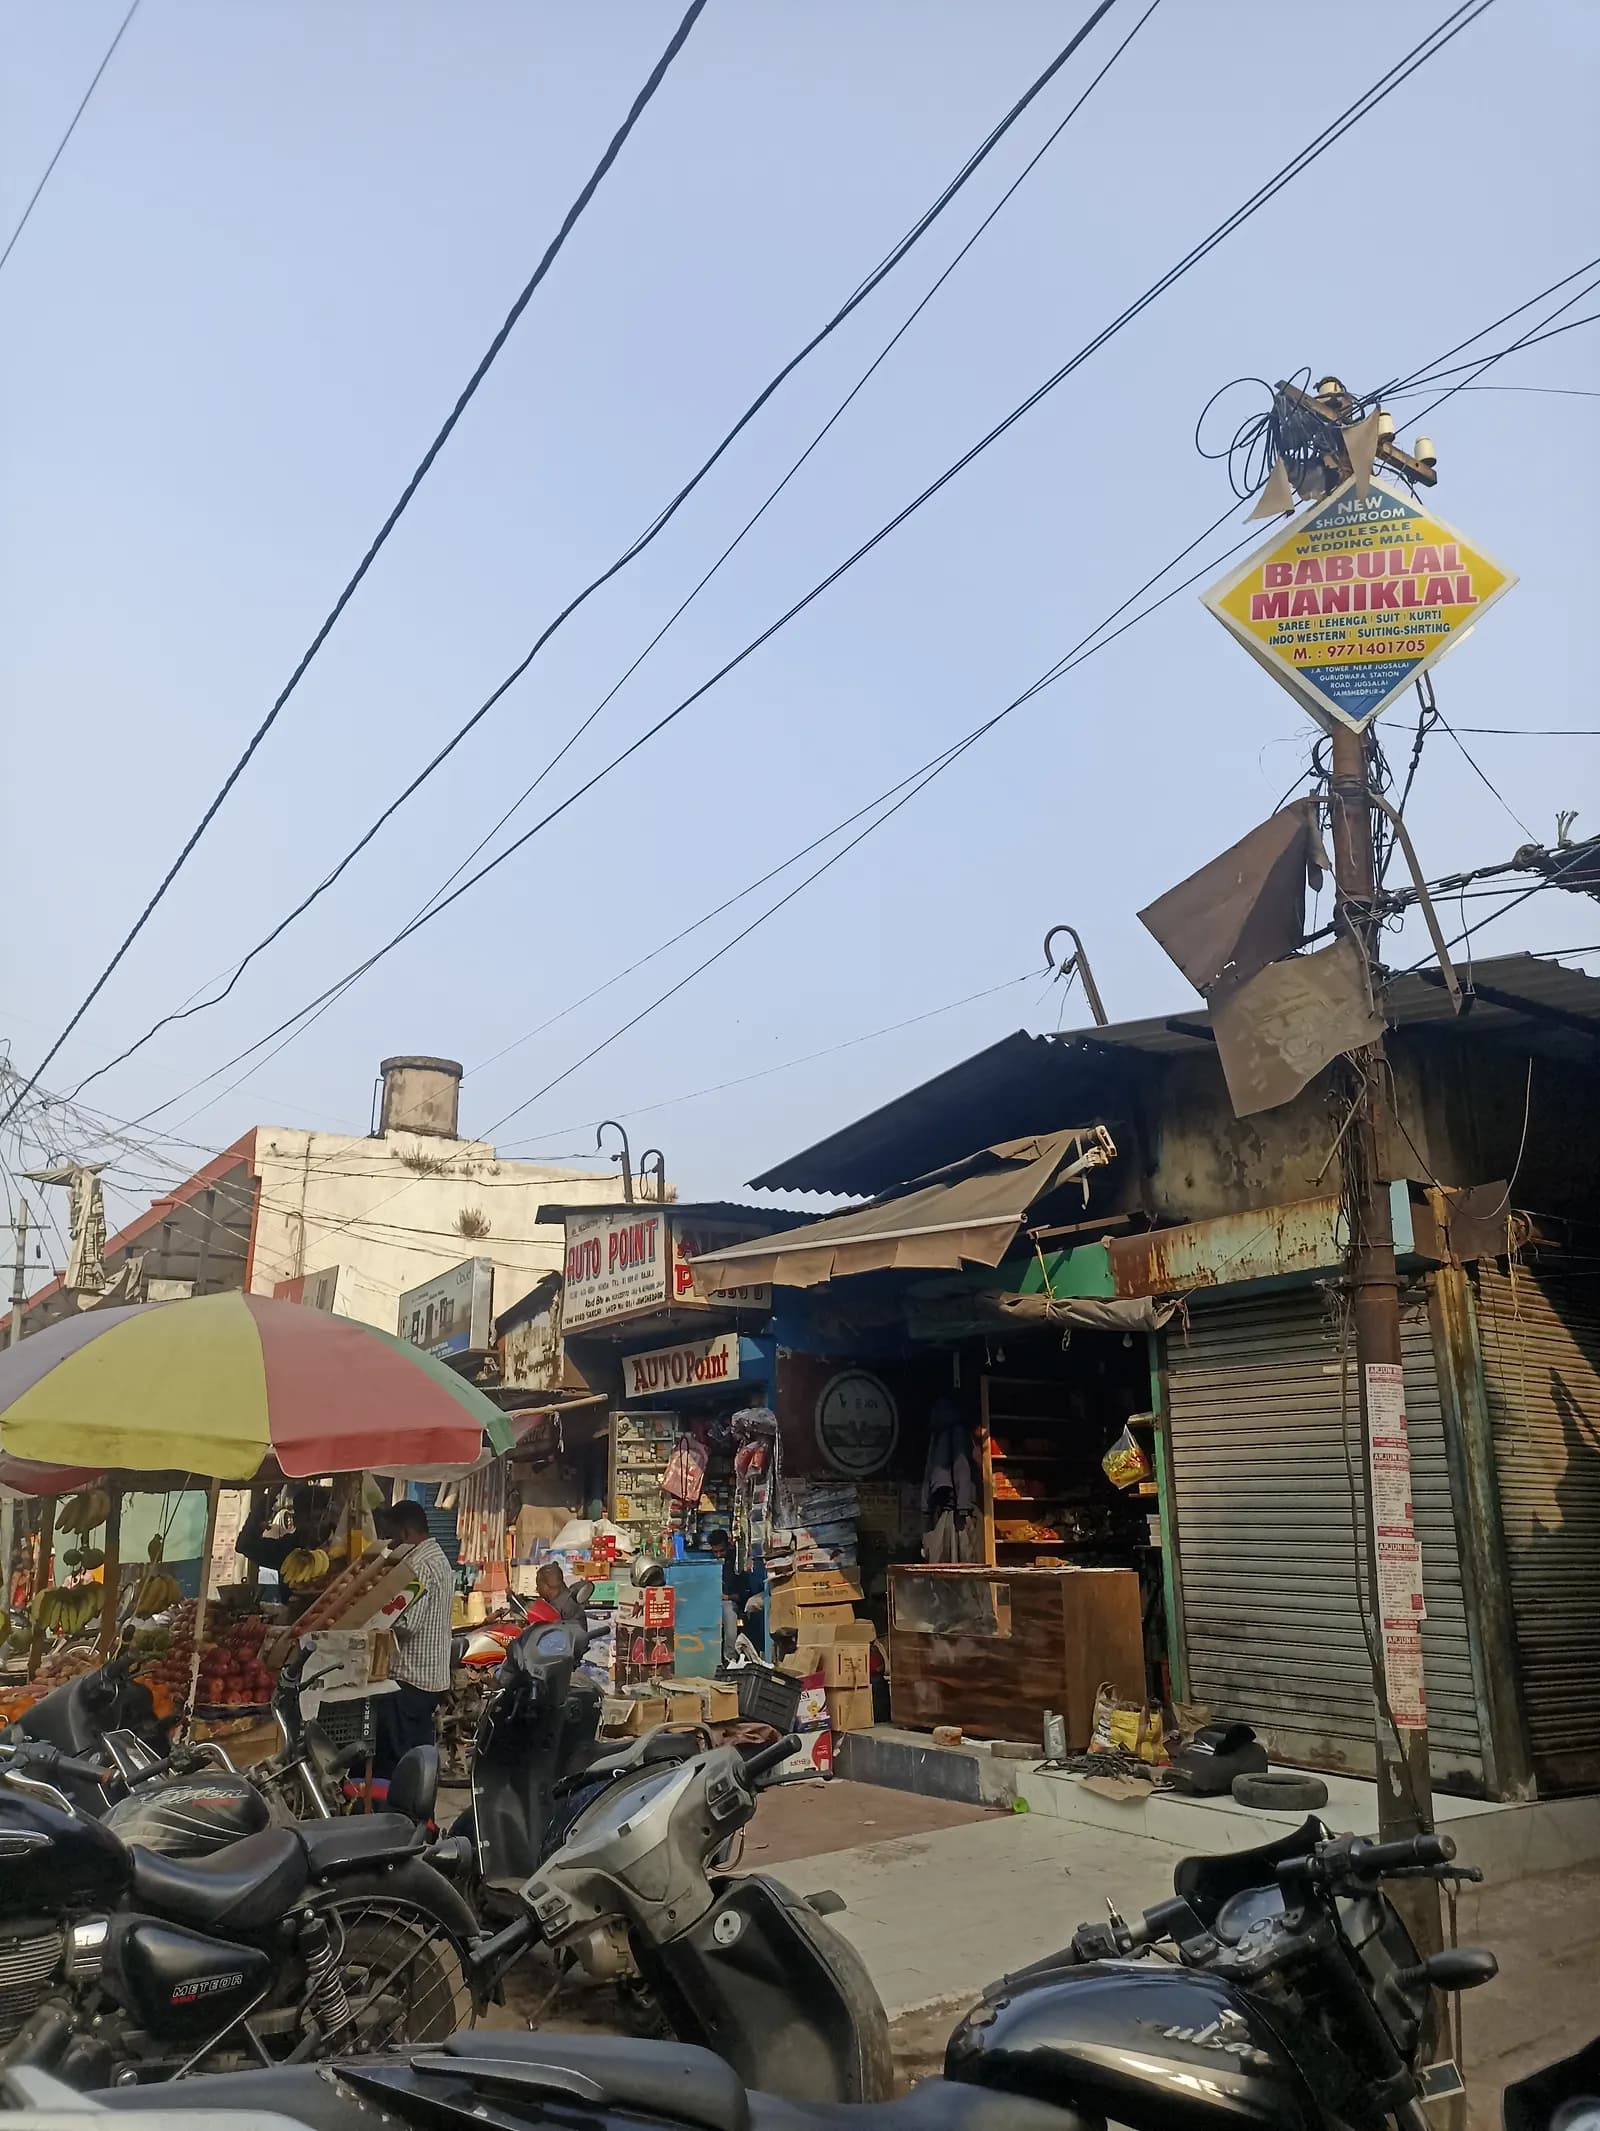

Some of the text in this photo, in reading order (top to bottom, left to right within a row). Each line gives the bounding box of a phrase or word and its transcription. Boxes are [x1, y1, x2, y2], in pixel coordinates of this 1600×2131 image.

[1337, 495, 1383, 514] NEW
[1316, 507, 1406, 529] SHOWROOM
[1309, 521, 1411, 542] WHOLESALE
[1296, 532, 1425, 555] WEDDING MALL
[1264, 543, 1465, 590] BABULAL
[1250, 574, 1479, 621] MANIKLAL
[1278, 610, 1441, 632] SAREE LEHENGA SUIT KURTI
[1269, 623, 1450, 645] INDO WESTERN SUITING-SHRTING
[1327, 640, 1425, 658] 9771401705
[567, 1237, 602, 1287] AUTO
[608, 1217, 660, 1275] POINT
[173, 1974, 243, 1997] METEOR
